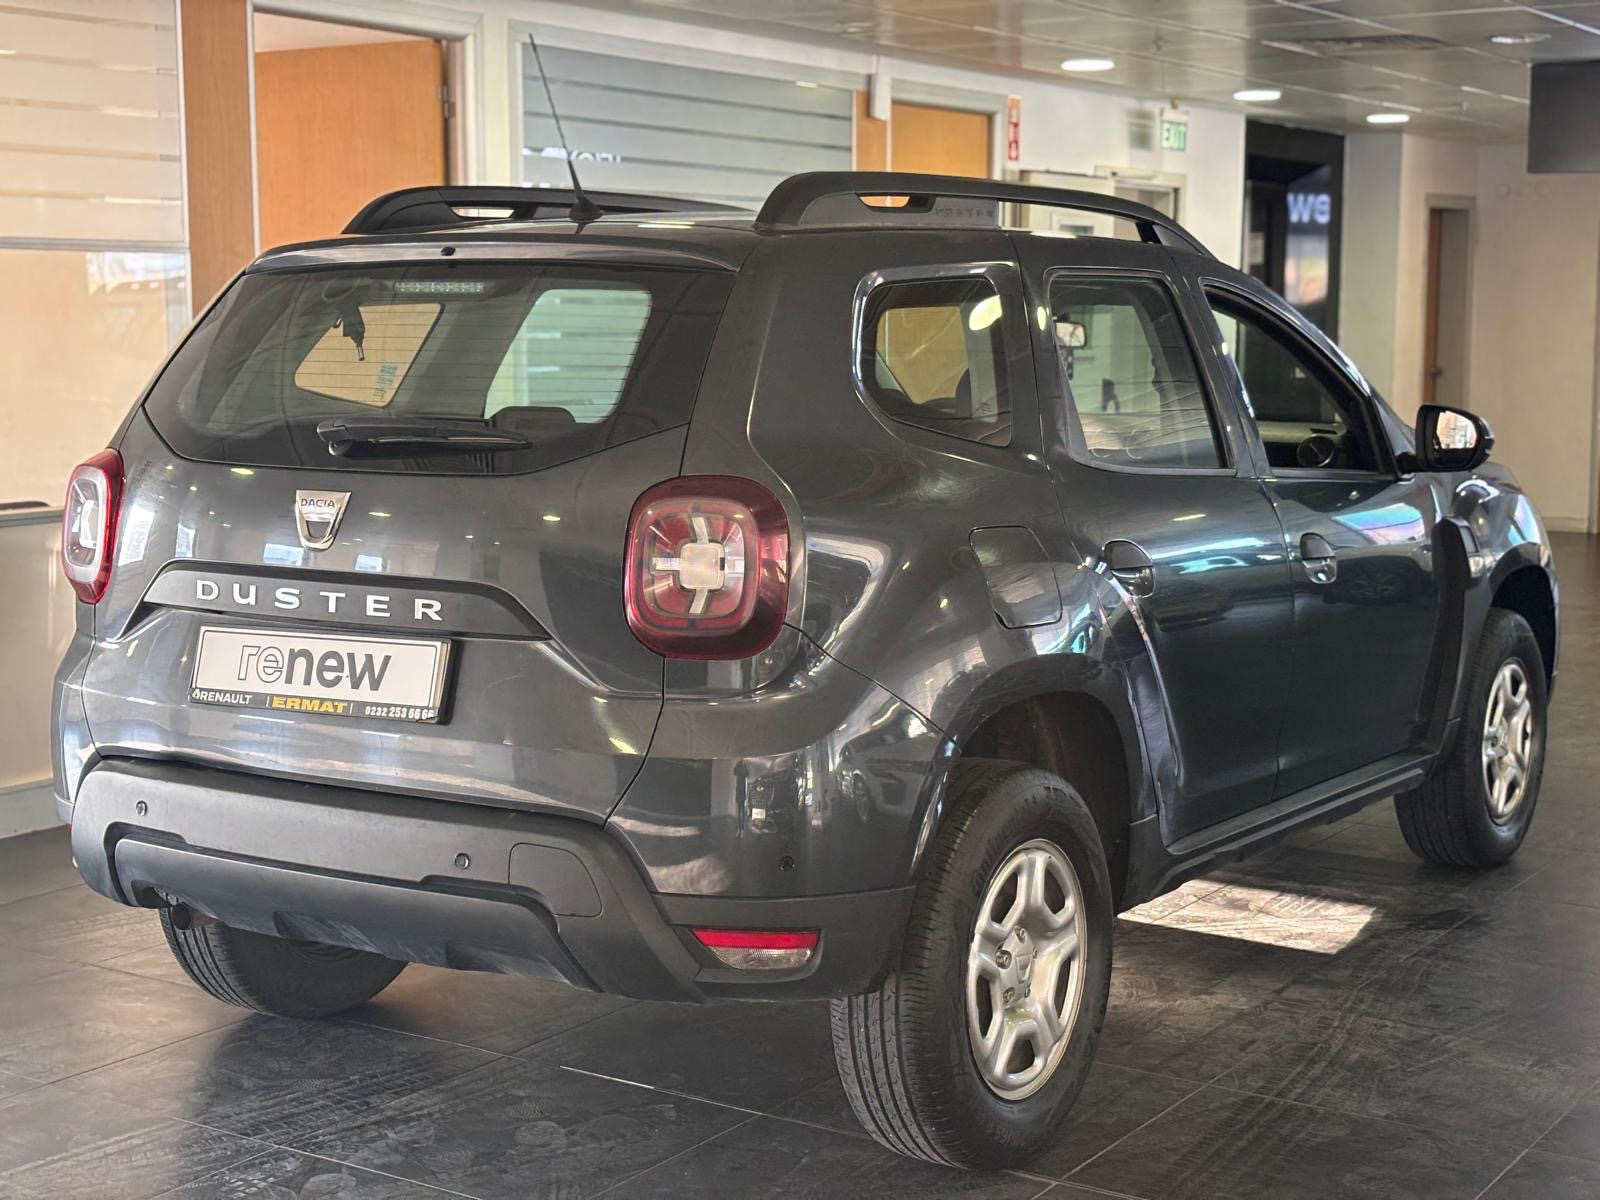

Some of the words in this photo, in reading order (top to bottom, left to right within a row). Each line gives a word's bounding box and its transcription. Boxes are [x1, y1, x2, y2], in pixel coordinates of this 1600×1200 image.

[301, 499, 335, 508] DACIA
[196, 580, 442, 621] DUSTER
[237, 645, 392, 692] renew
[200, 690, 252, 705] RENAULT
[272, 696, 347, 713] ERMAT
[365, 706, 388, 716] 0232
[389, 706, 407, 717] 253
